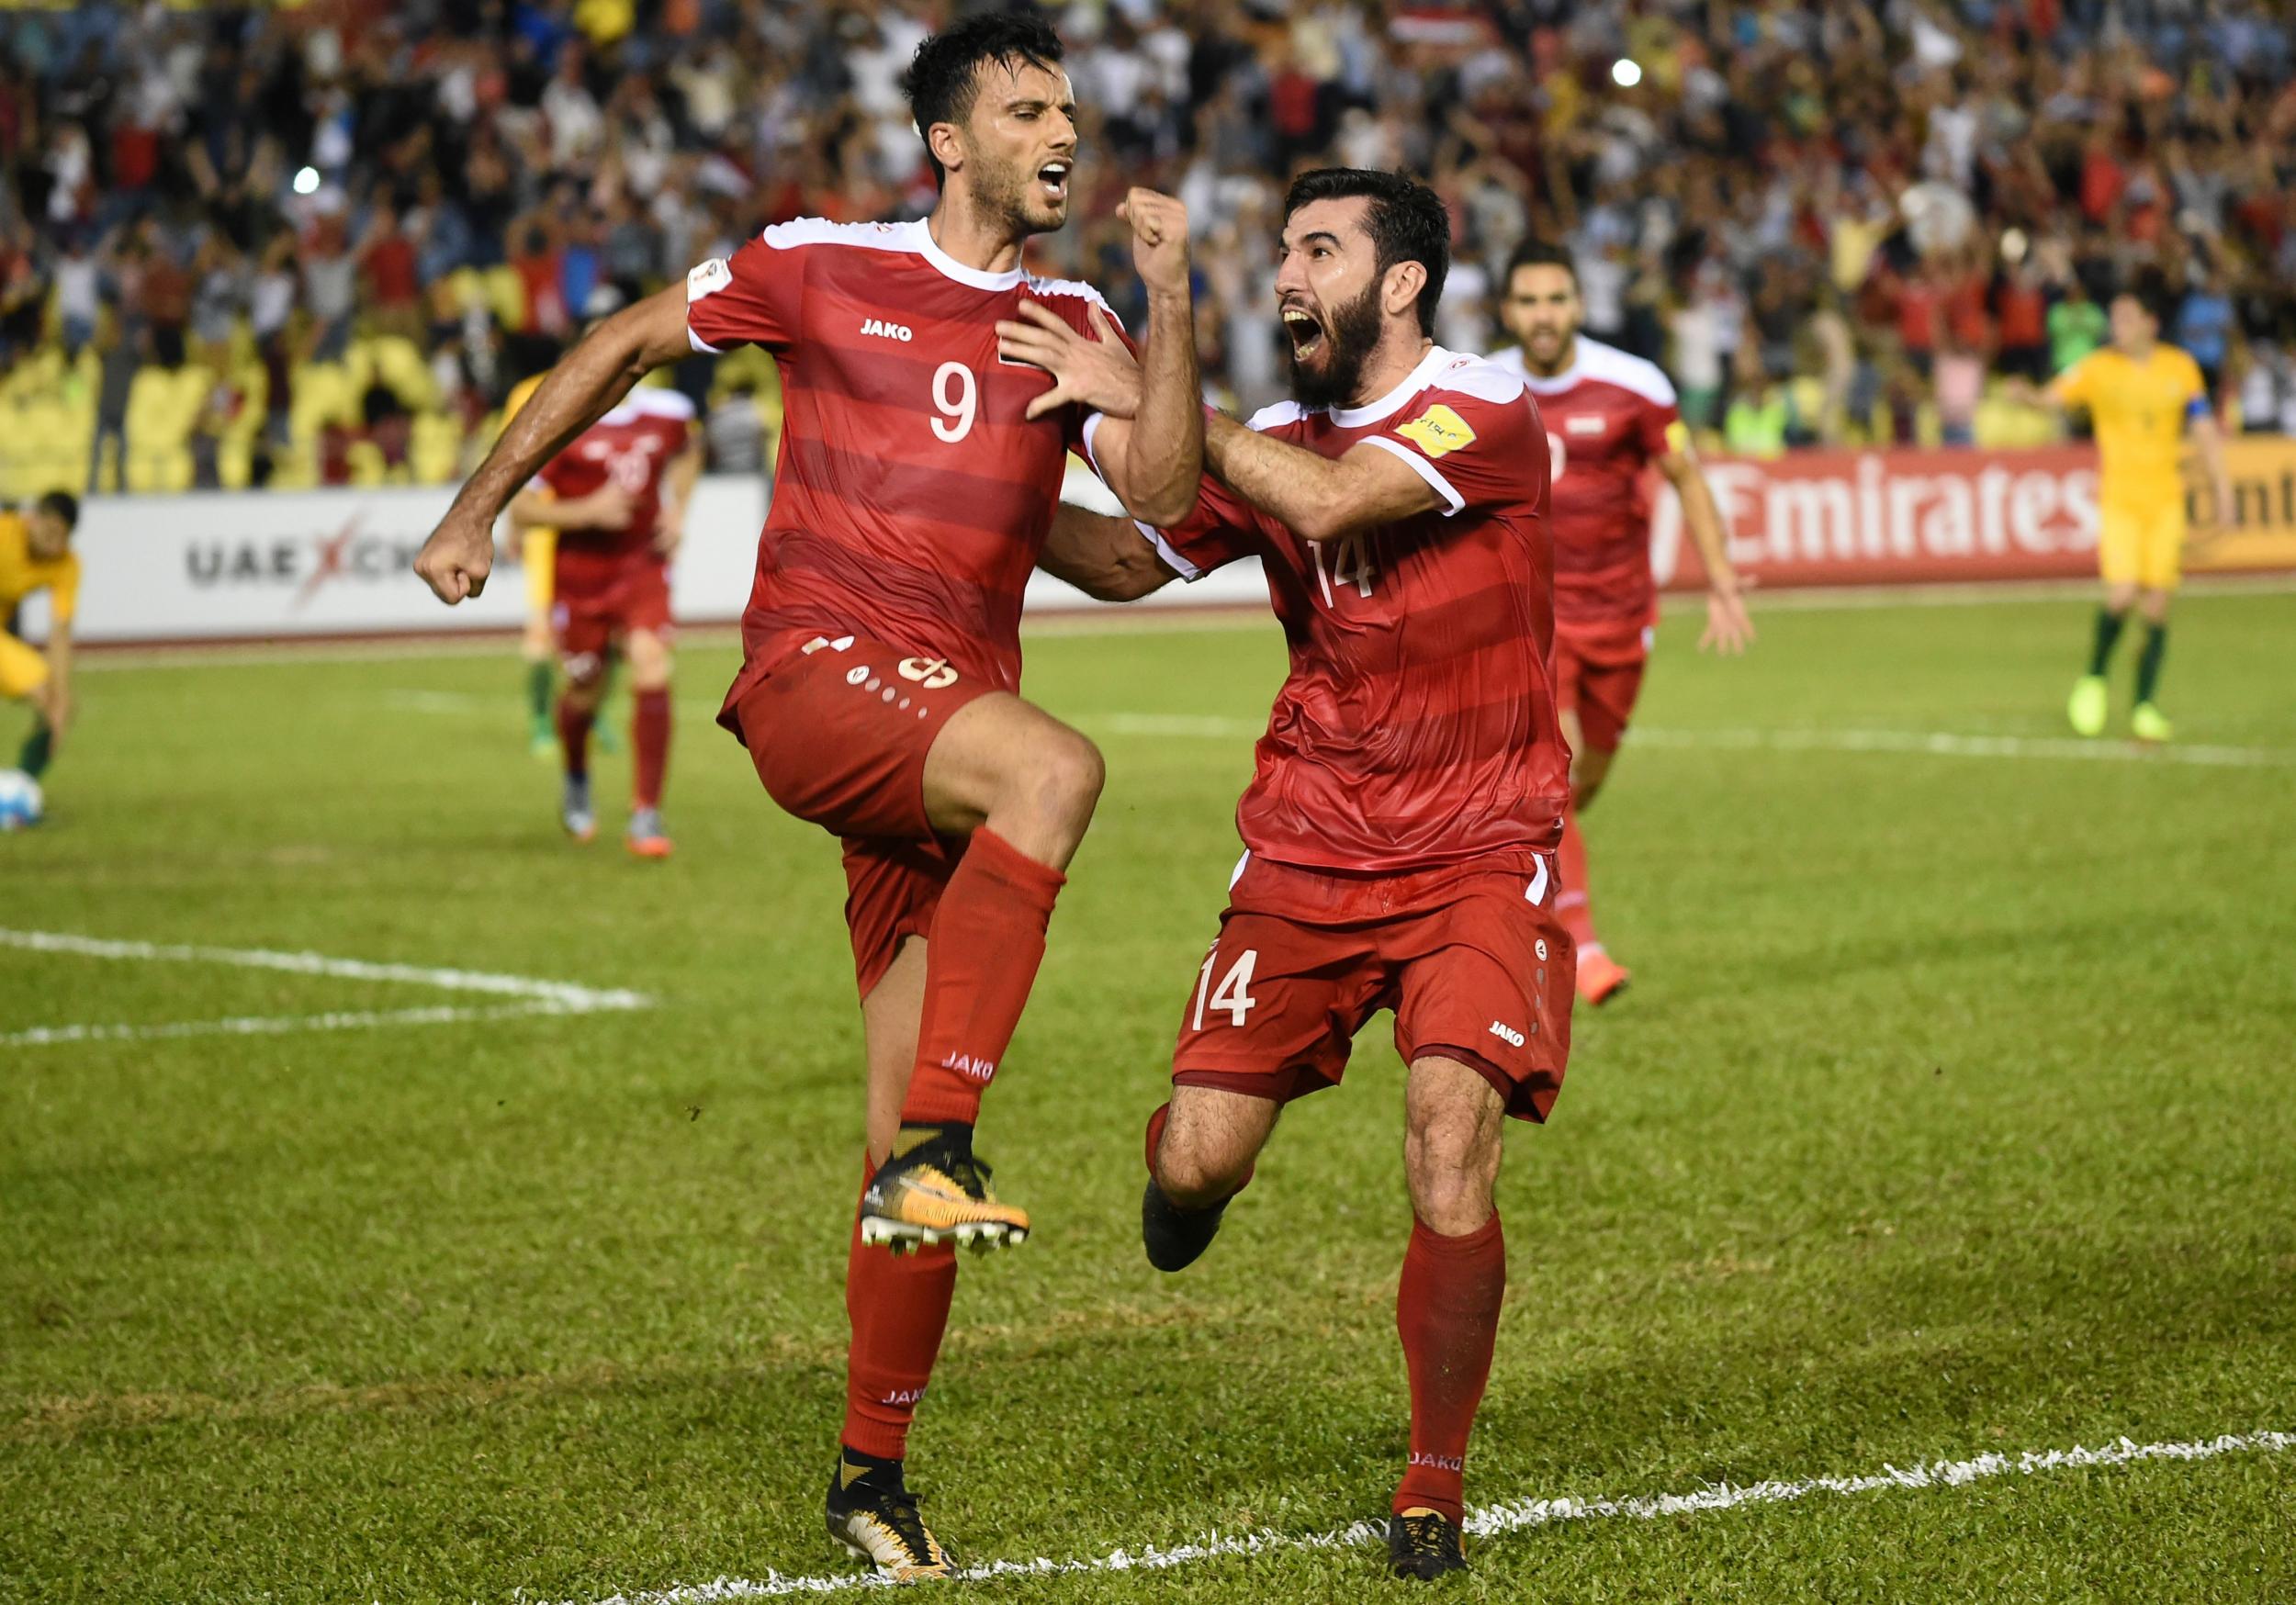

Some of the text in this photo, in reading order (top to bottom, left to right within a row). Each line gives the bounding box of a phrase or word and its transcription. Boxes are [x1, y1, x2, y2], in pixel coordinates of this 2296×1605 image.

[860, 318, 913, 342] JAKO
[929, 361, 976, 443] 9
[1705, 455, 2101, 564] Emirates
[1307, 532, 1377, 609] 14
[1192, 949, 1257, 1030] 14
[1489, 1020, 1525, 1047] JAKO
[941, 1050, 994, 1081] JAKO
[882, 1386, 927, 1404] JAK
